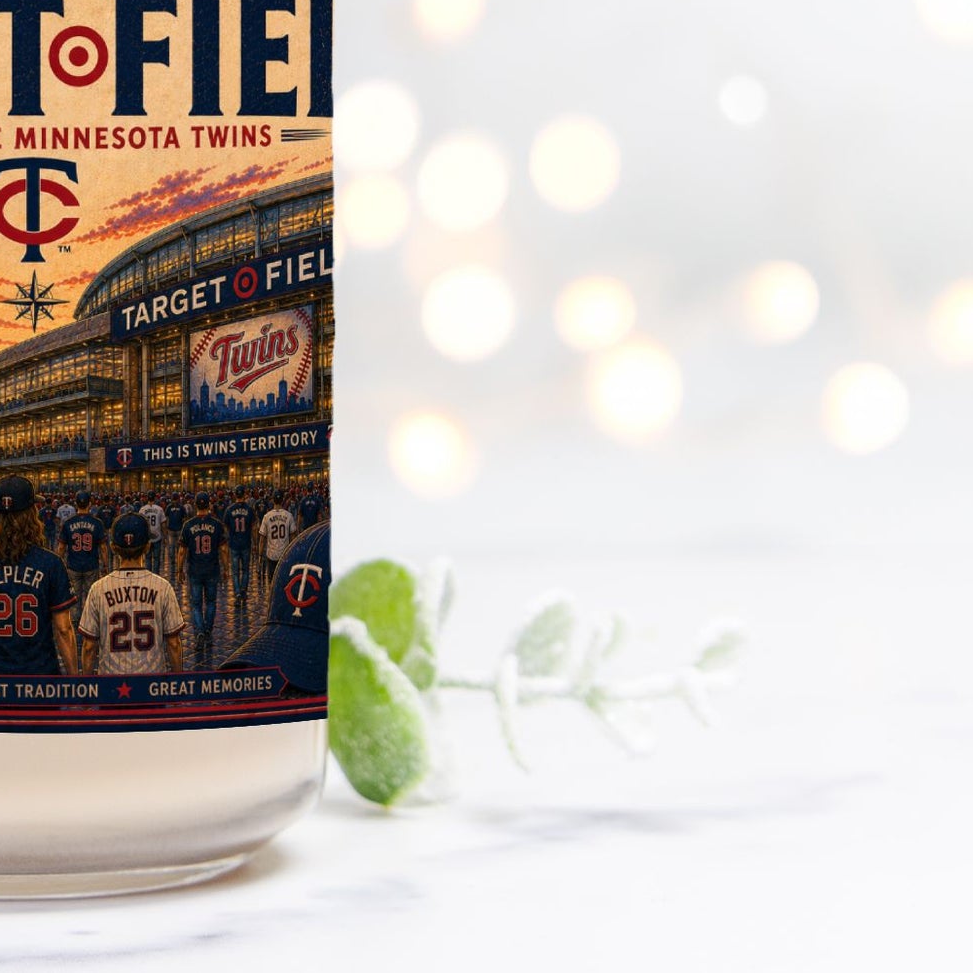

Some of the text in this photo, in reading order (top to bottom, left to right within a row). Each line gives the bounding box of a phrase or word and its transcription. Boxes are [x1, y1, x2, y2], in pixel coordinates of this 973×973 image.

[14, 126, 180, 150] MINNESOTA
[190, 124, 272, 149] TWINS
[58, 245, 71, 253] TM
[122, 275, 226, 331] TARGET
[209, 322, 300, 394] Twins
[143, 446, 173, 461] THIS
[177, 445, 189, 458] IS
[194, 439, 236, 456] TWINS
[241, 429, 318, 451] TERRITORY
[71, 532, 92, 552] 39
[271, 524, 286, 540] 20
[104, 585, 158, 608] BUXTON
[109, 610, 155, 653] 25
[15, 682, 98, 698] TRADITION
[149, 675, 272, 697] GREAT MEMORIES
